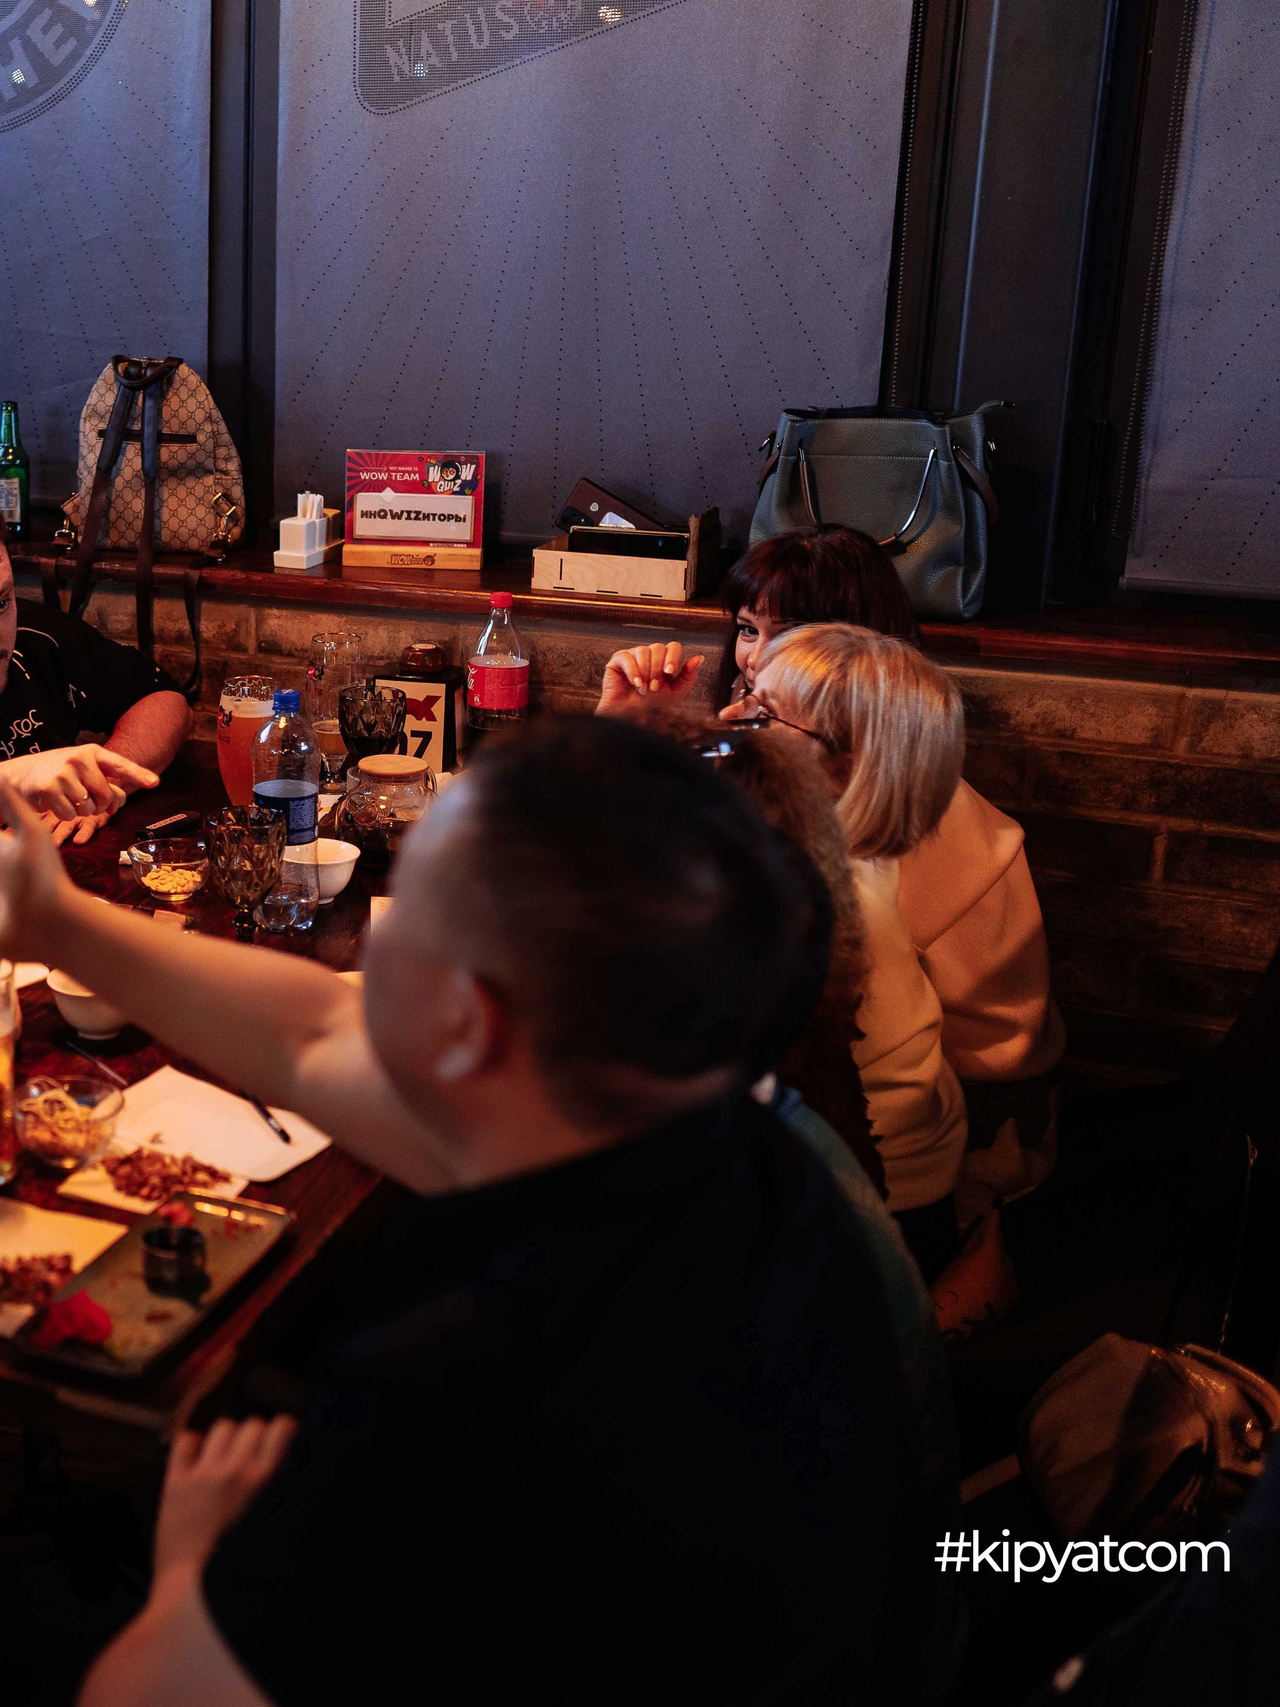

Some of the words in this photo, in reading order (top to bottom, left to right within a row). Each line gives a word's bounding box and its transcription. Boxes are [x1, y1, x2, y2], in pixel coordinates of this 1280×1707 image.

[360, 472, 388, 480] WOW
[390, 473, 419, 481] TEAM
[436, 480, 463, 492] QUIZ
